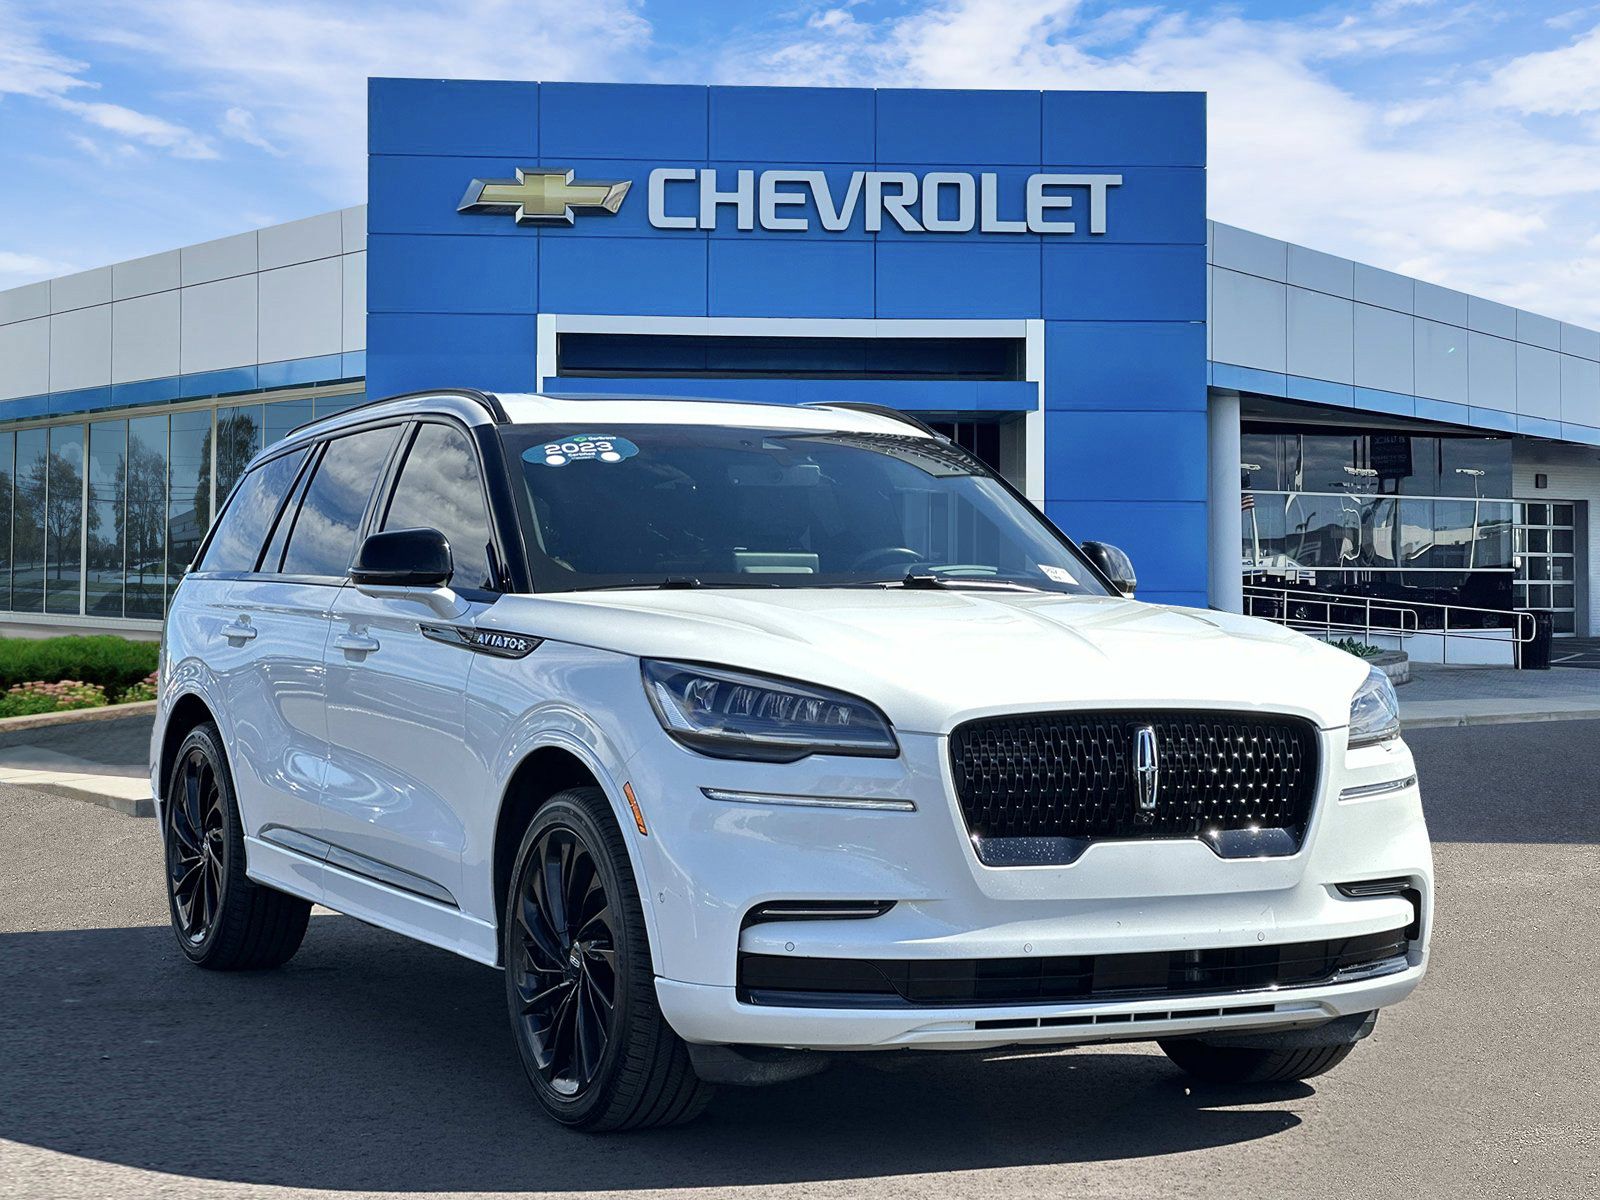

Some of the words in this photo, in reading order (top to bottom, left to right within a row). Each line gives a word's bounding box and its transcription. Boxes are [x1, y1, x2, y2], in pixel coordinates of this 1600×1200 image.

[648, 167, 1124, 235] CHEVROLET
[544, 441, 614, 455] 2023
[477, 633, 527, 651] AVIATOR
